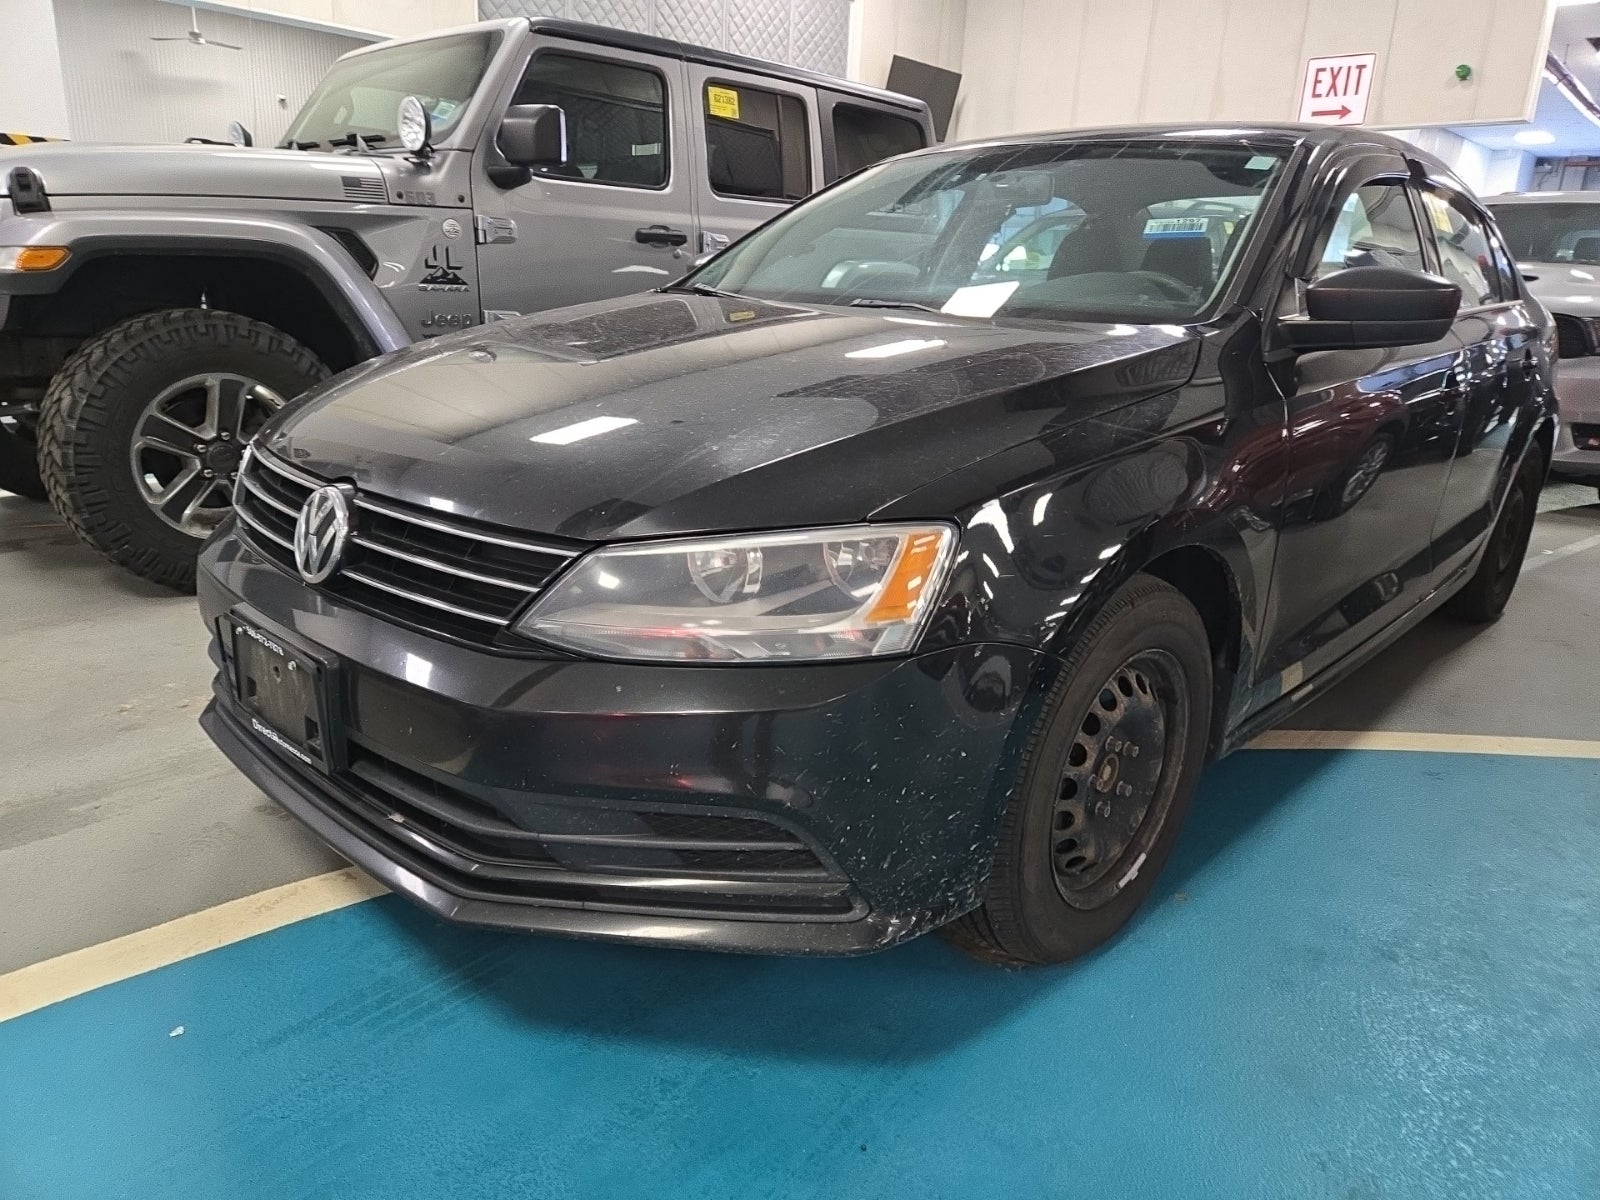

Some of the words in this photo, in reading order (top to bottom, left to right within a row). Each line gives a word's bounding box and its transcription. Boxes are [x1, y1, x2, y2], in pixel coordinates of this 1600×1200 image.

[1312, 64, 1367, 98] EXIT
[424, 244, 464, 270] JL
[418, 284, 470, 293] SAHARA
